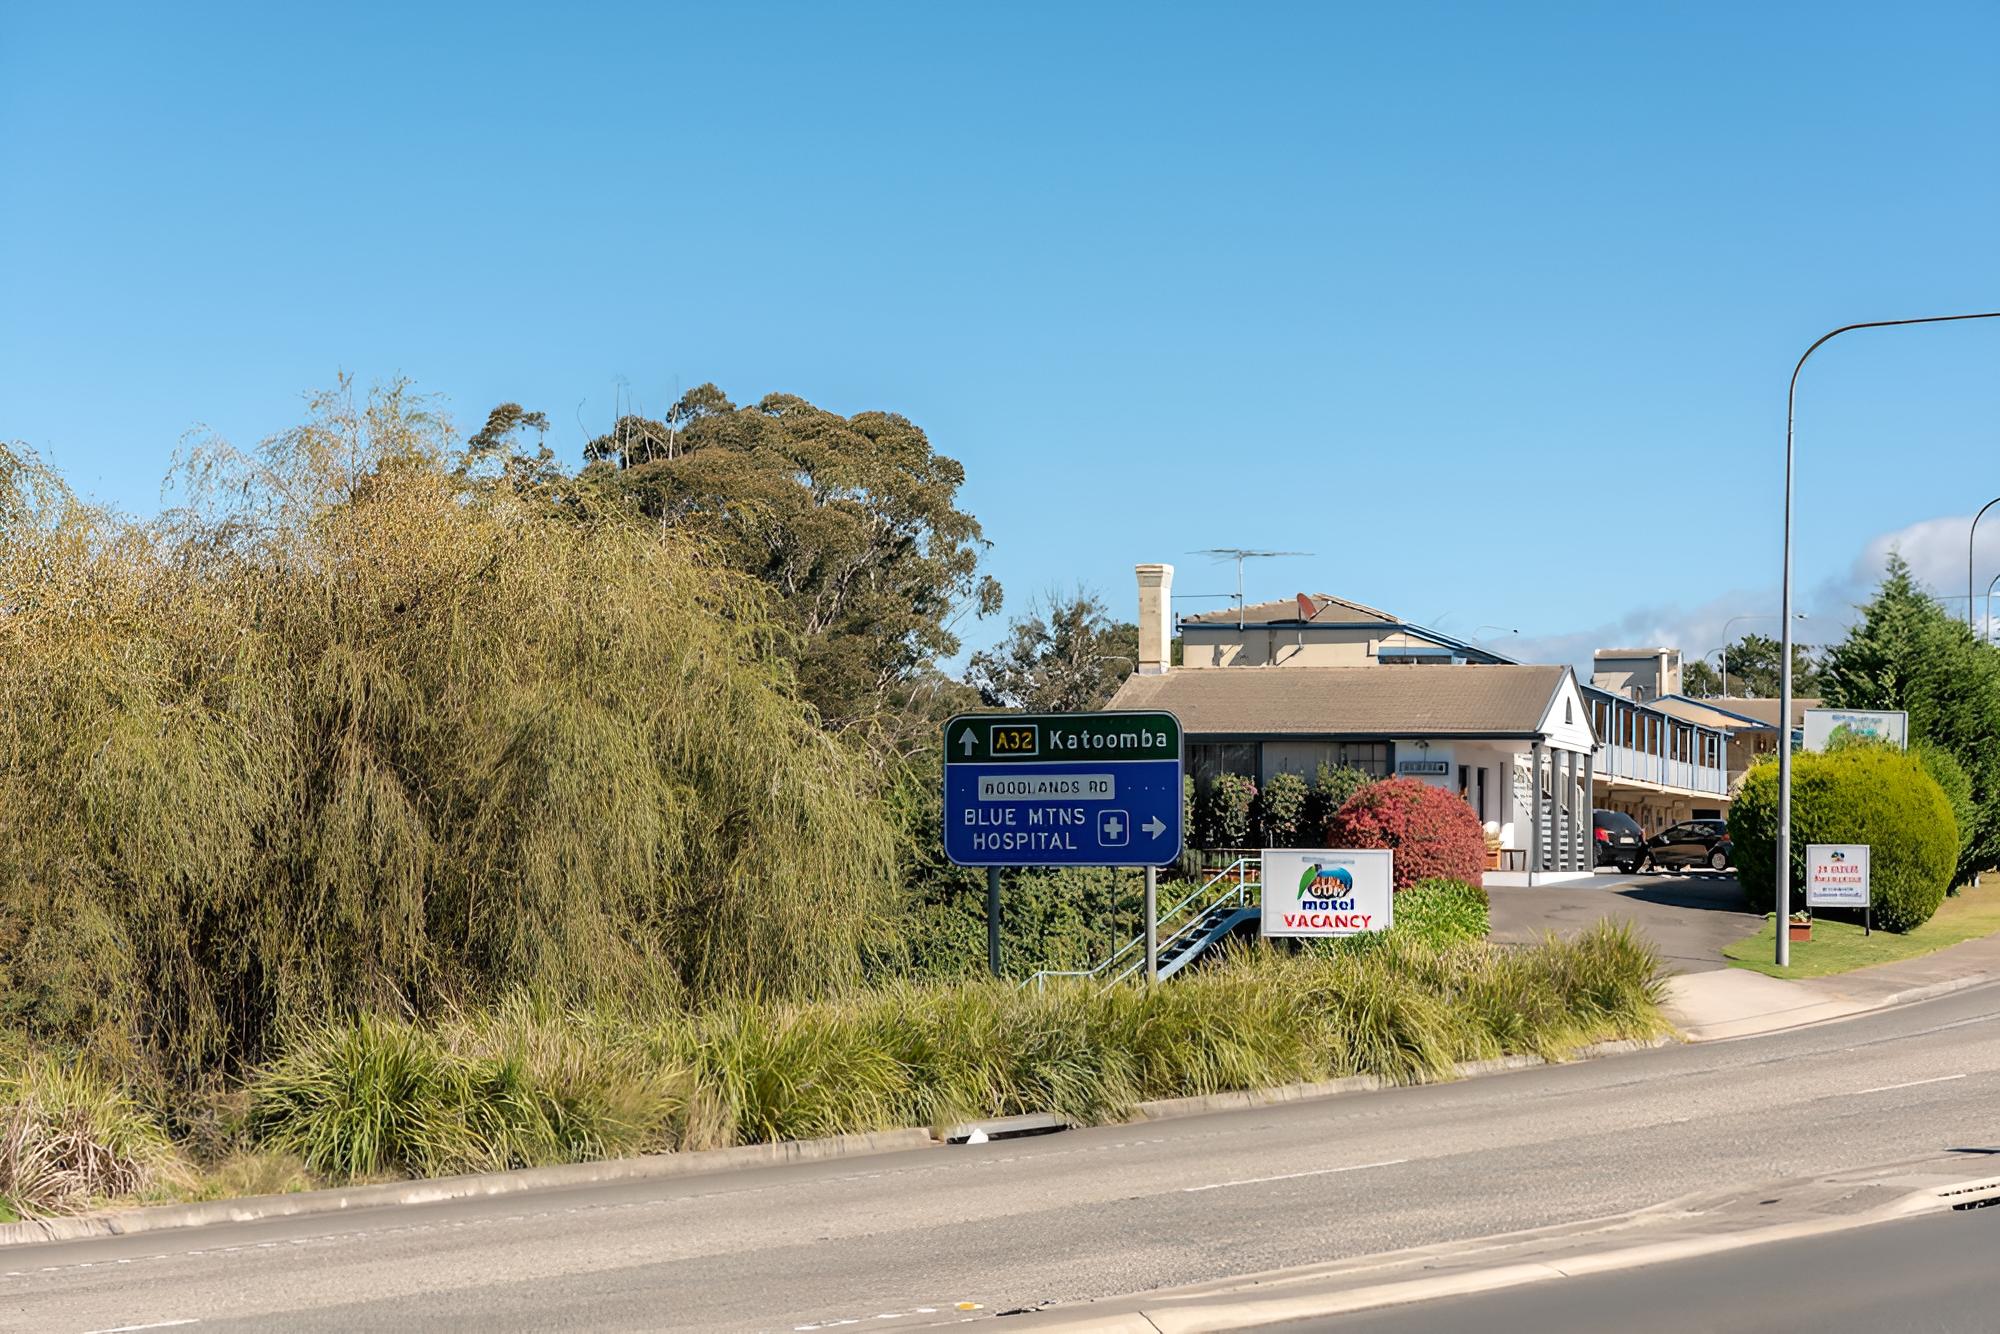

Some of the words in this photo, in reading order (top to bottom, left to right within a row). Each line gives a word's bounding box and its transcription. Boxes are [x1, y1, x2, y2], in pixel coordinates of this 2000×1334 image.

[996, 731, 1033, 750] A32
[1049, 729, 1167, 750] Katoomba
[964, 808, 1017, 826] BLUE
[1029, 808, 1086, 825] MTNS
[973, 832, 1078, 850] HOSPITAL
[1283, 914, 1372, 929] VACANCY
